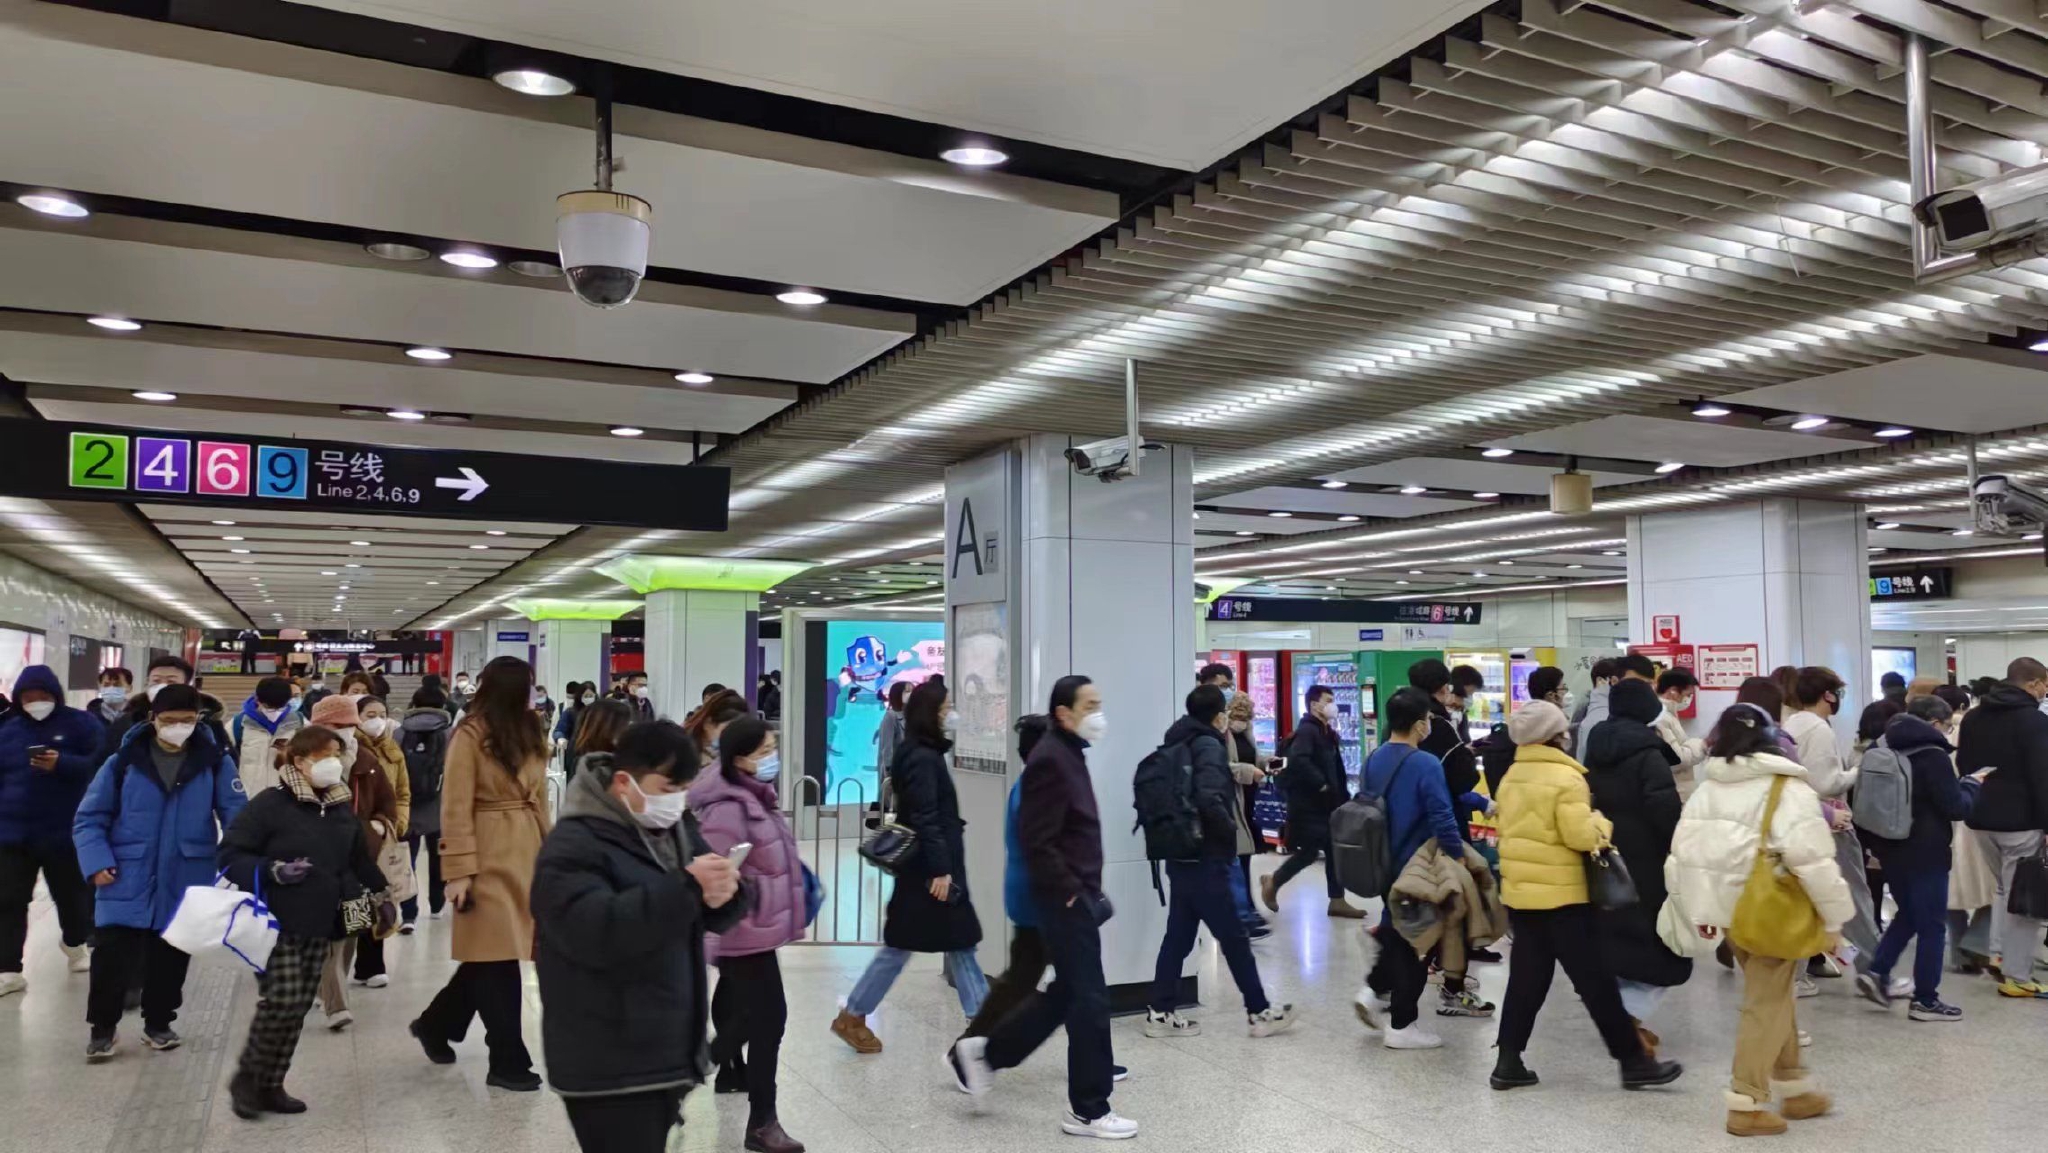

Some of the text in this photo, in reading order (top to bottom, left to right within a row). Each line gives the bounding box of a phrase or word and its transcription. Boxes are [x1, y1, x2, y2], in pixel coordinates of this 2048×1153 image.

[84, 439, 385, 492] 2 4 6 9 号线
[317, 483, 353, 498] Line
[1879, 580, 1890, 594] 9
[1219, 602, 1230, 617] 4
[1433, 606, 1443, 621] 6
[1676, 653, 1693, 663] AED
